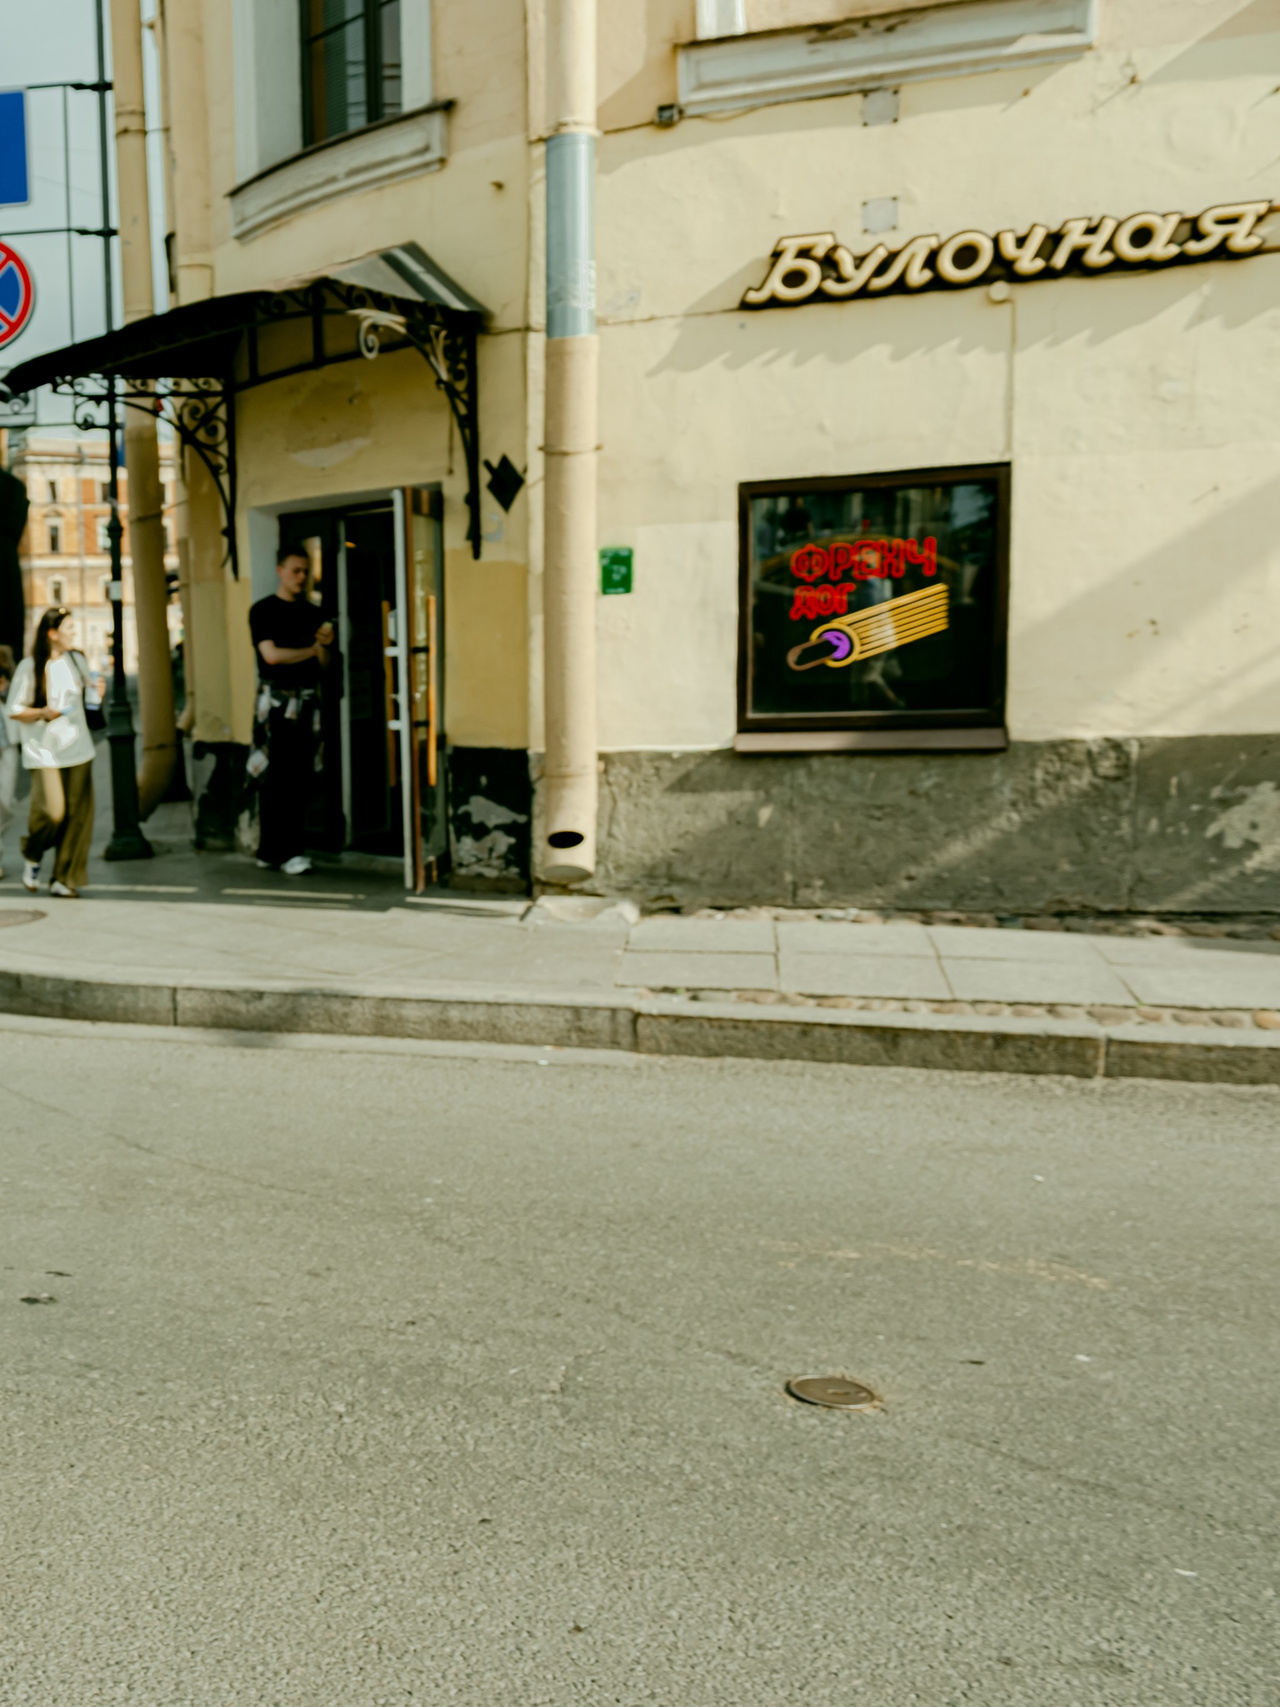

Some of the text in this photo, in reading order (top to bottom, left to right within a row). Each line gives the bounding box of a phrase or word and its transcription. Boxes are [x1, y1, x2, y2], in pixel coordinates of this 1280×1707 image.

[742, 201, 1271, 305] Булочная
[791, 537, 937, 582] ФРЕНЧ
[789, 583, 856, 620] ДОГ
